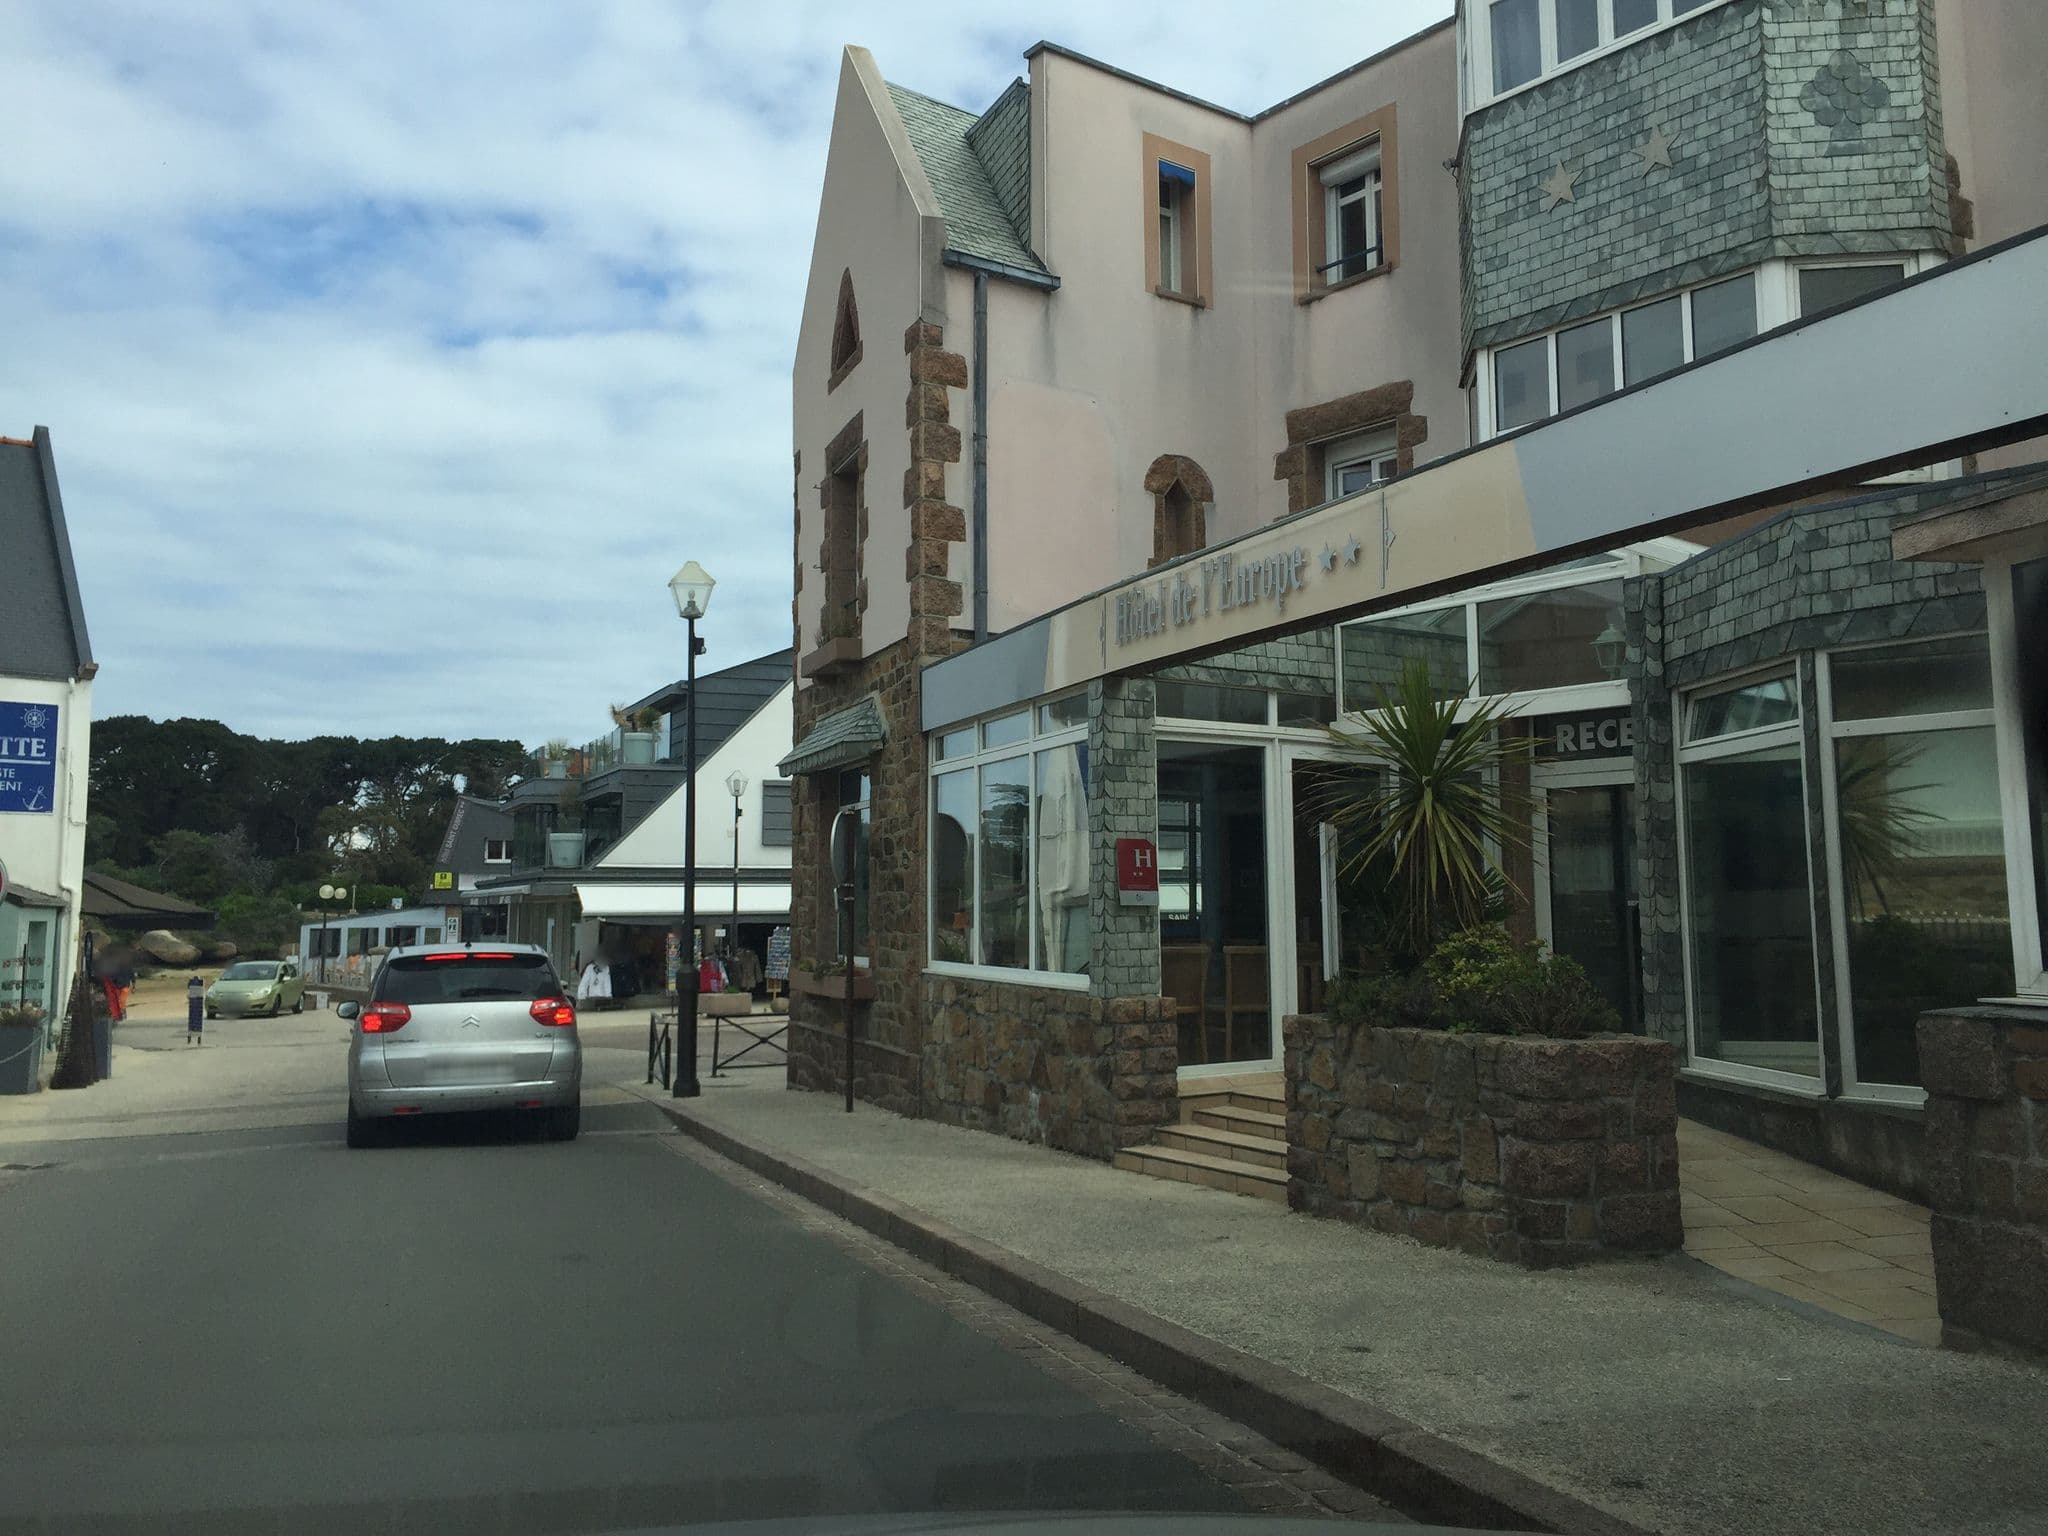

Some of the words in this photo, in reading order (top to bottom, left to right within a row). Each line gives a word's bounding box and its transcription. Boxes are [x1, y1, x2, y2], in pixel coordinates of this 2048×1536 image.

[1114, 581, 1167, 645] Hôtel
[1172, 573, 1198, 625] de
[1200, 545, 1304, 614] l'Europe
[1134, 848, 1152, 868] H
